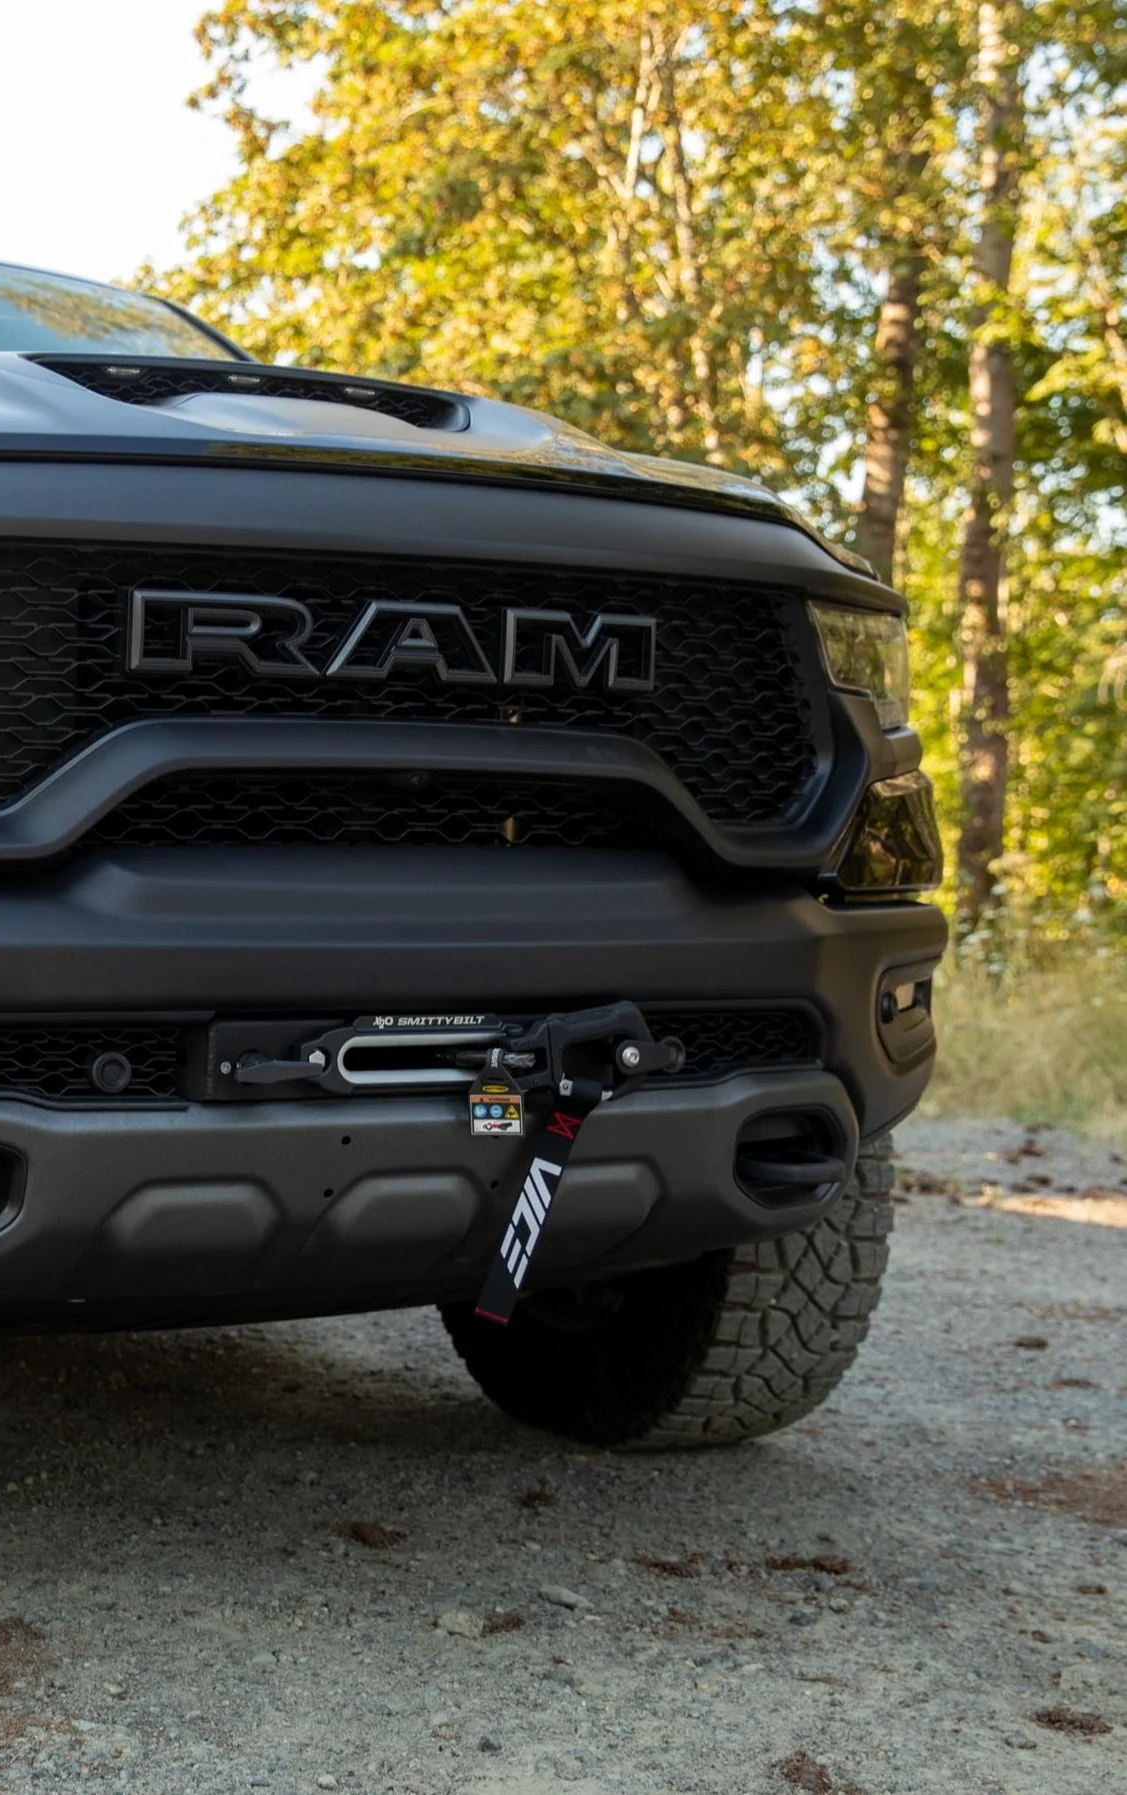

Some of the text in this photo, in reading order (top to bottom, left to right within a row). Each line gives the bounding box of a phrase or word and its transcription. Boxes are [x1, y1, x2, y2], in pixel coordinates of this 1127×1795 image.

[130, 589, 657, 692] RAM
[397, 1015, 485, 1026] SMITTYBILT
[500, 1157, 562, 1289] VICE
